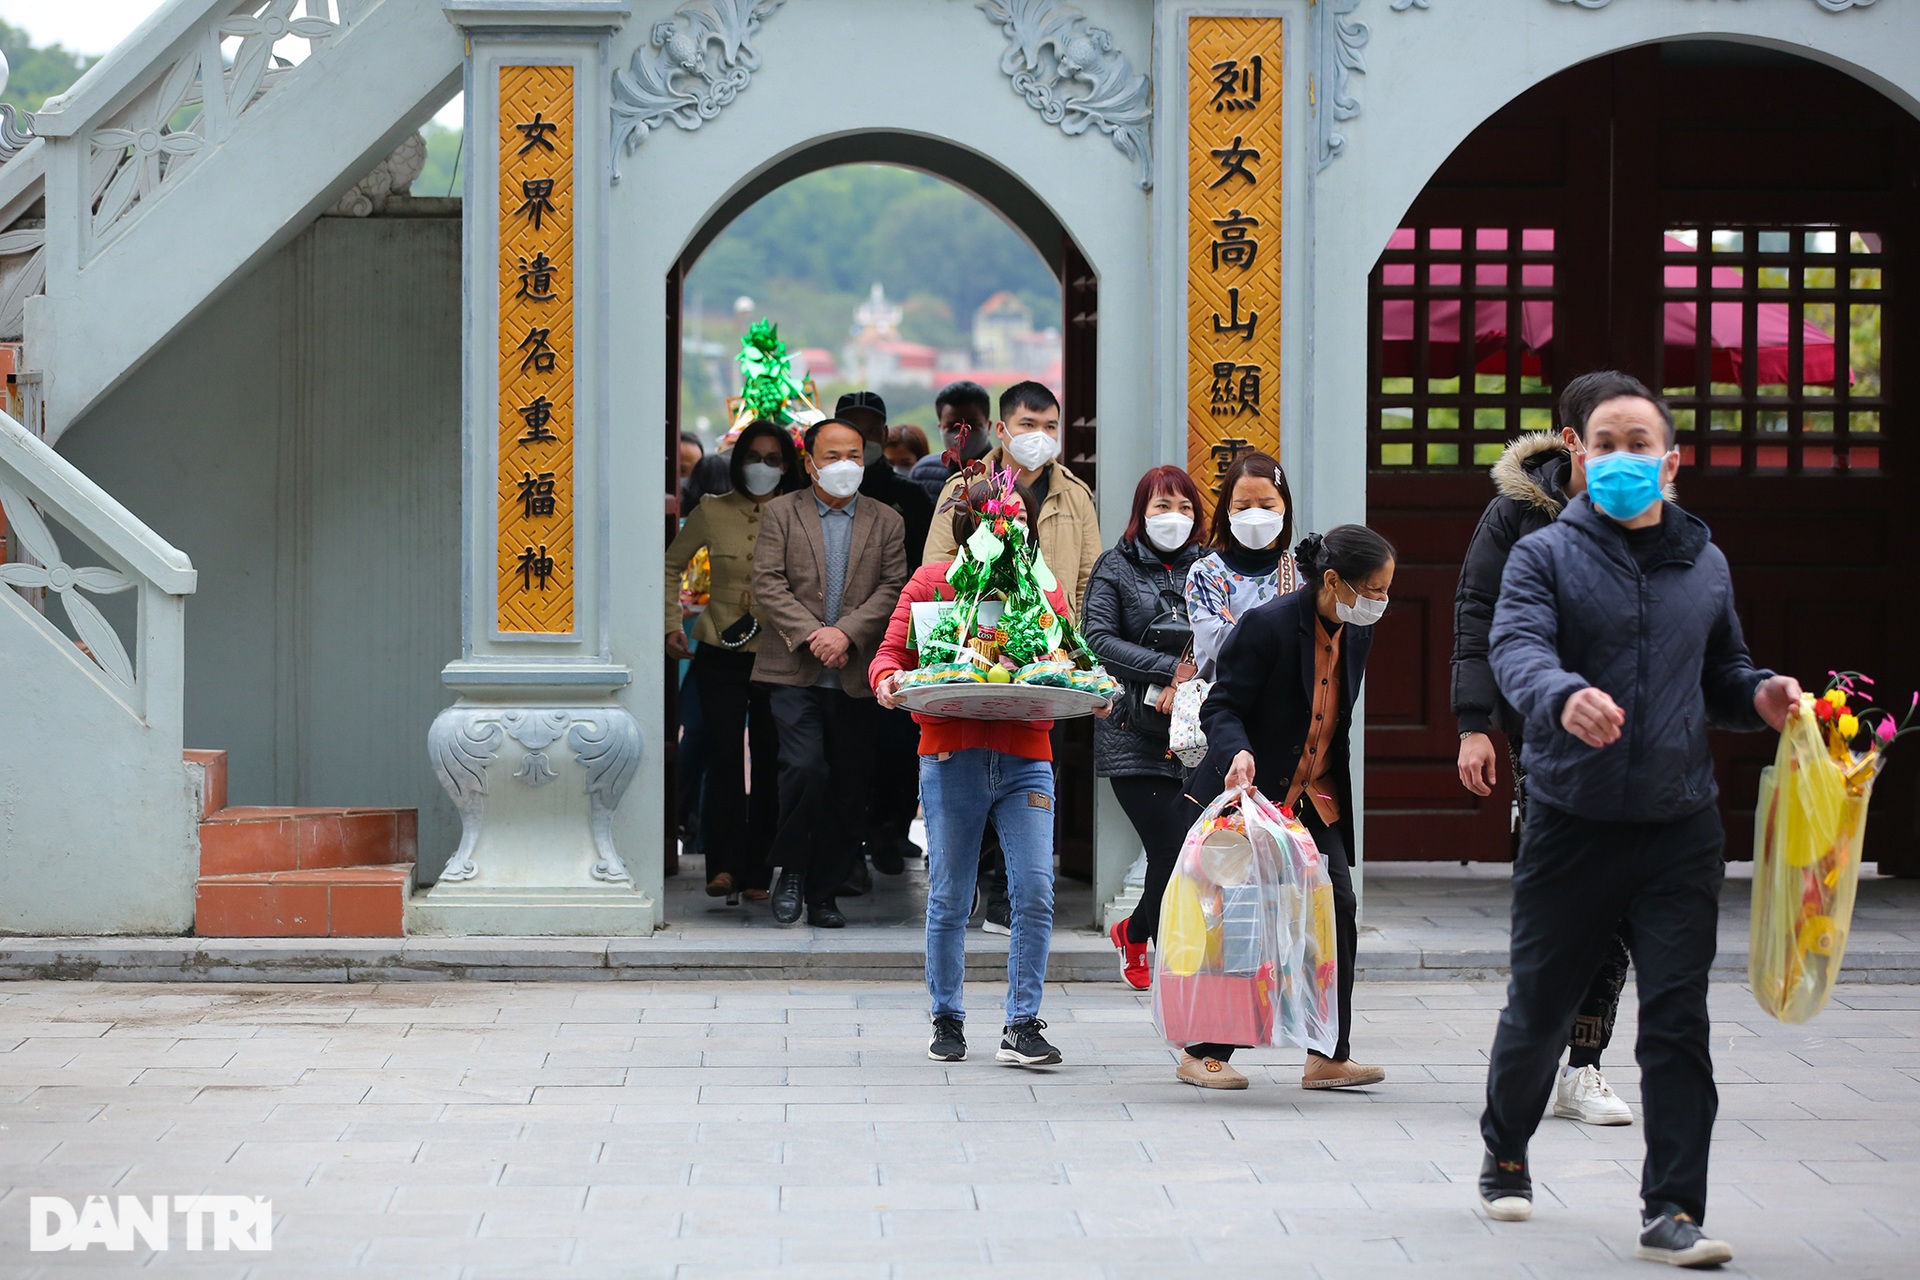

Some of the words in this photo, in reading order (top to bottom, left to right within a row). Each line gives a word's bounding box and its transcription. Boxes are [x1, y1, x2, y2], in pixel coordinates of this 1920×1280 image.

[515, 112, 558, 592] 女界遺名重福神
